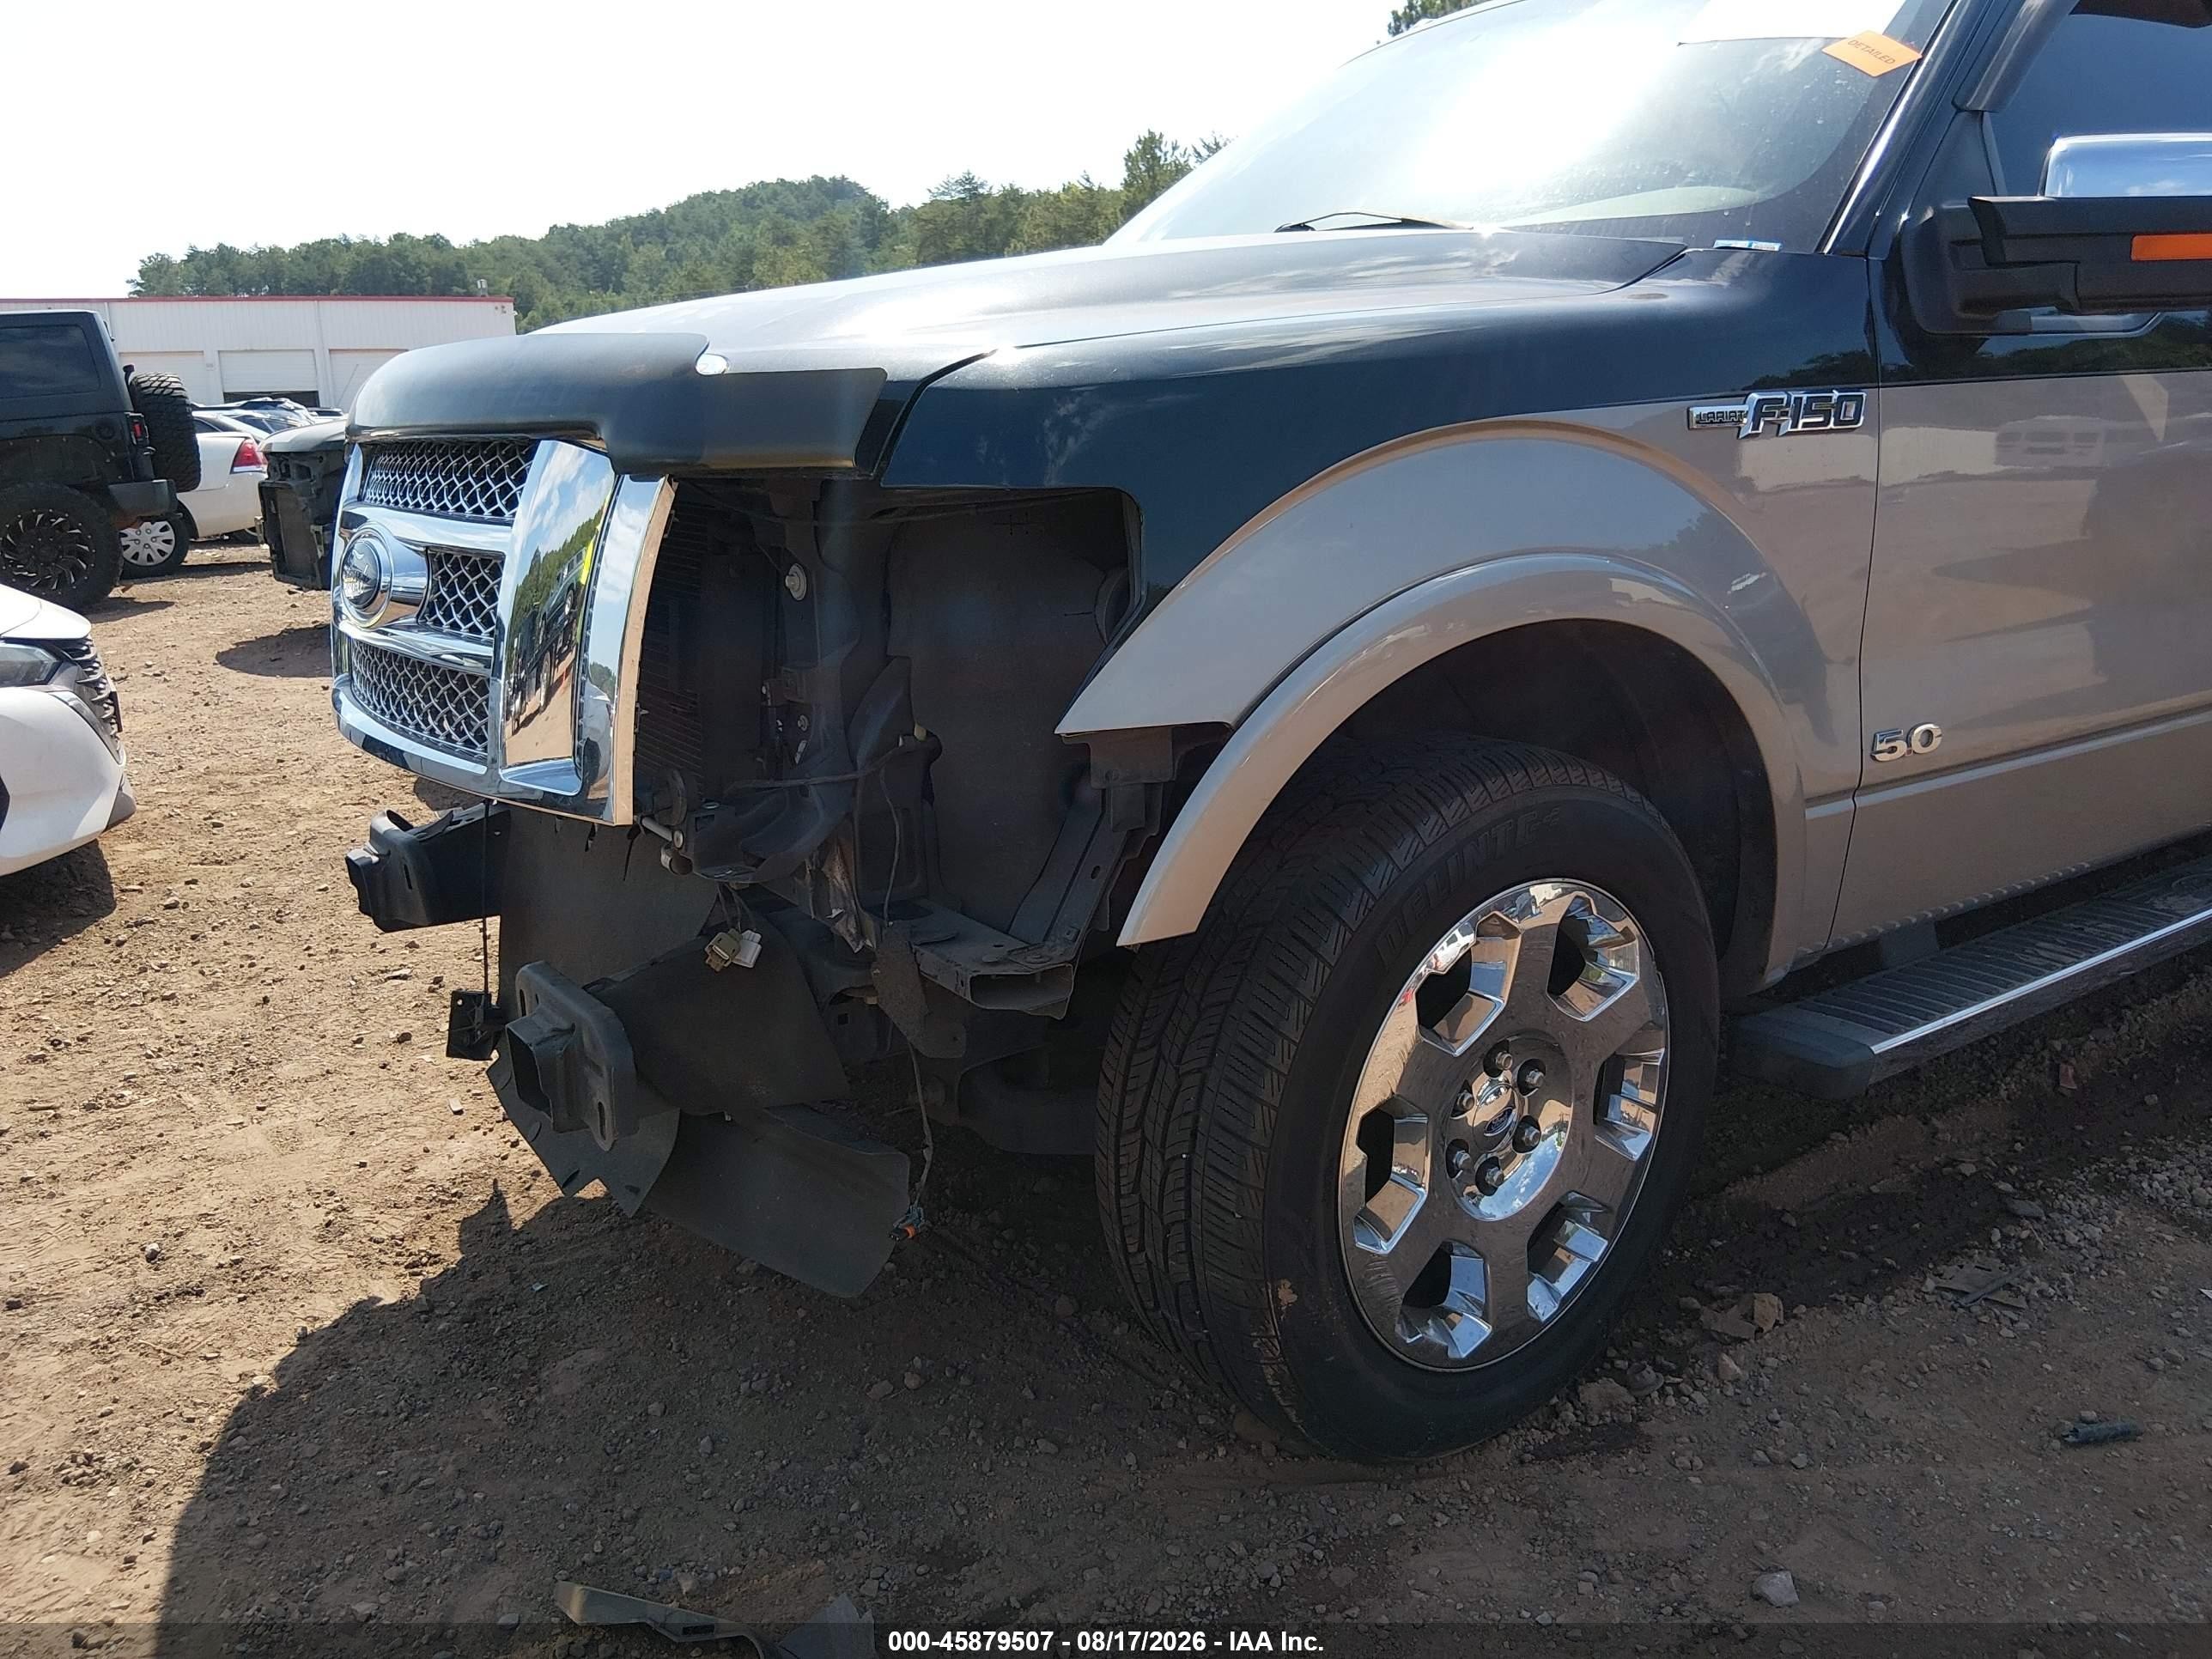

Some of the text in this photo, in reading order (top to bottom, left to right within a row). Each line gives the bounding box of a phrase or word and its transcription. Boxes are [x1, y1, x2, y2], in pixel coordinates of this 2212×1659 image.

[1848, 40, 1896, 64] DETAILED
[1698, 410, 1747, 424] LARIAT
[1870, 723, 1943, 762] 5.0
